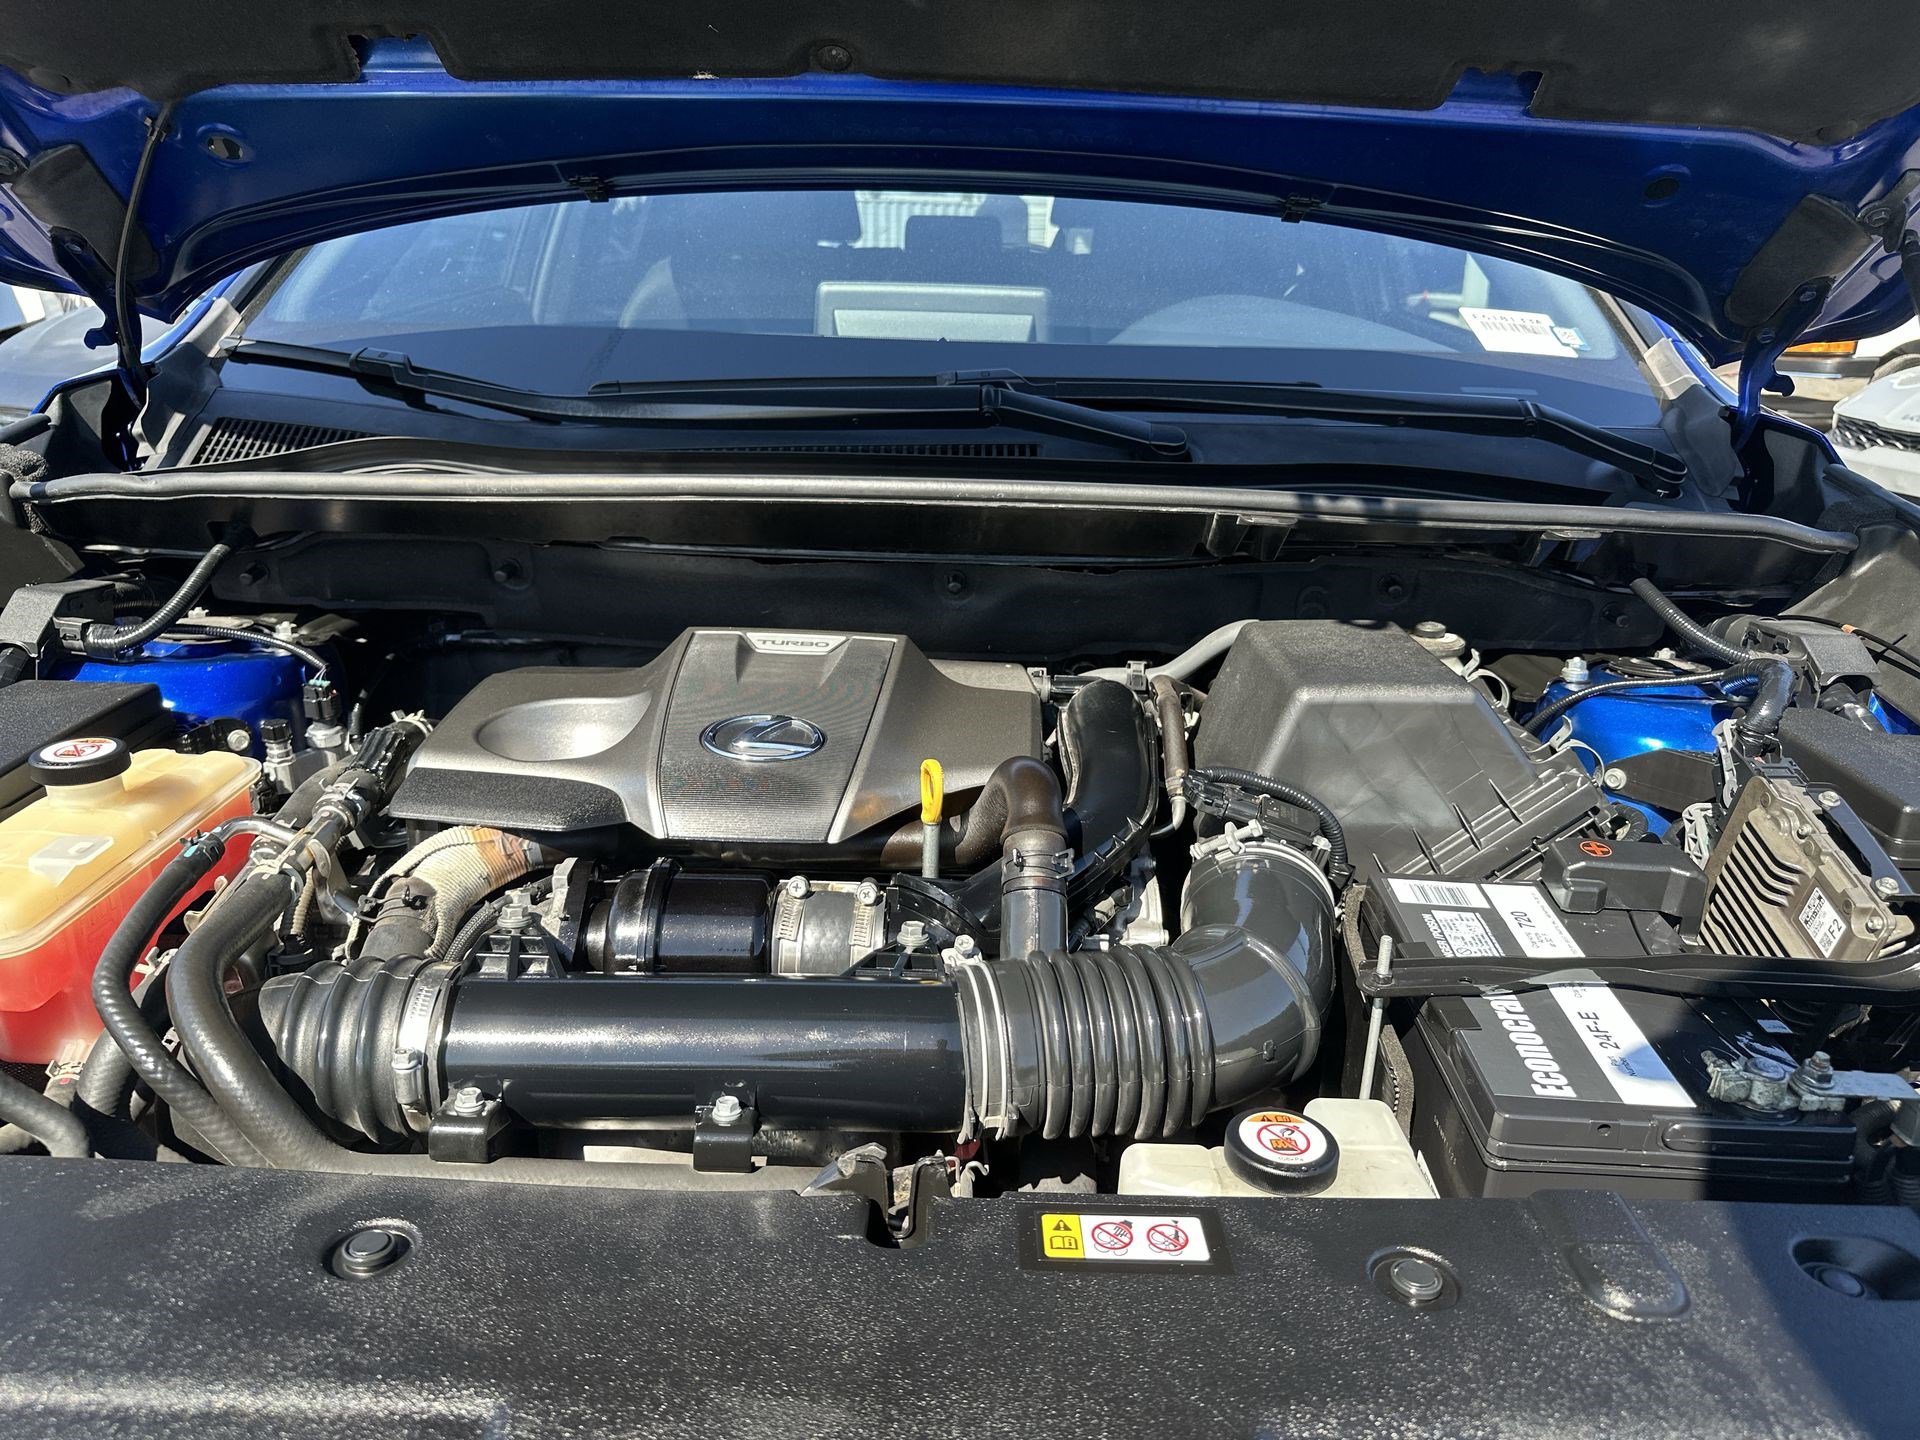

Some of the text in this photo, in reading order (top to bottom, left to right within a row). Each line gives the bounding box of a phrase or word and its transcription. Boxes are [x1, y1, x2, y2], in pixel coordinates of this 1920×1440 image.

[757, 638, 830, 649] TURBO
[1510, 910, 1536, 929] 720
[1436, 939, 1455, 958] NGER
[1577, 1011, 1621, 1050] 24F-E
[1483, 993, 1578, 1098] Econocra
